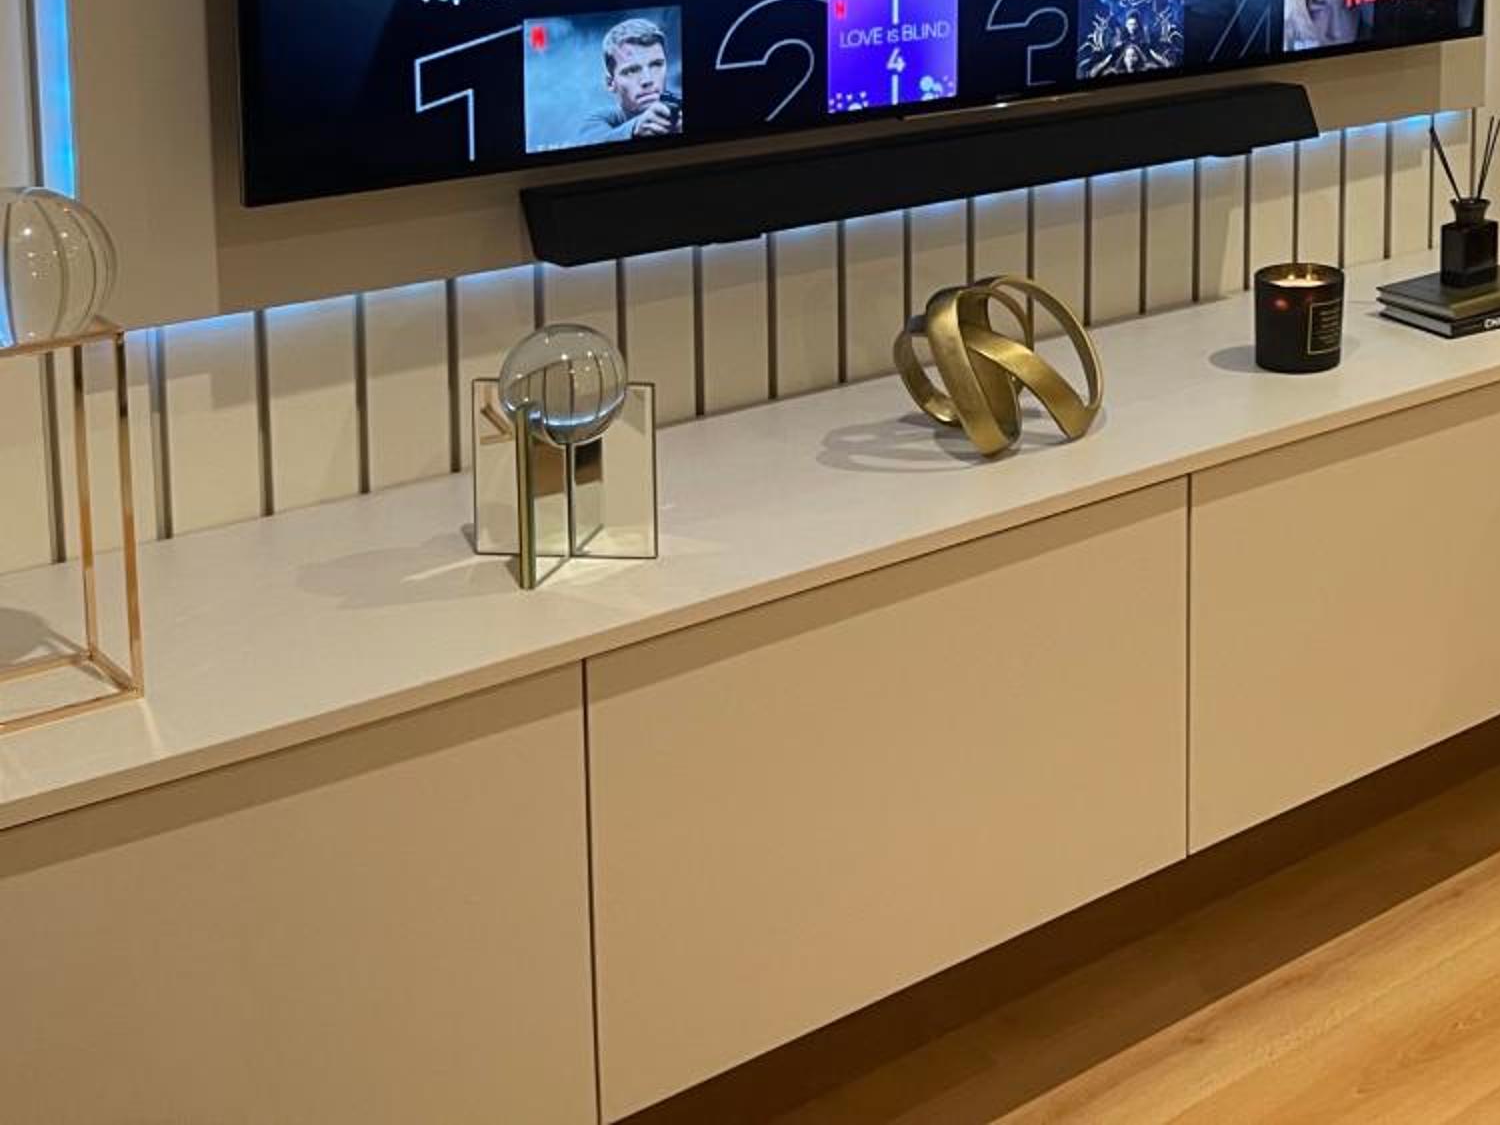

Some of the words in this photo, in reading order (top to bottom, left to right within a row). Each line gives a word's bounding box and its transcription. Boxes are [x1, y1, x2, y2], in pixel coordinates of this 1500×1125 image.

[839, 27, 883, 48] LOVE
[902, 21, 950, 42] BLIND
[886, 48, 906, 73] 4
